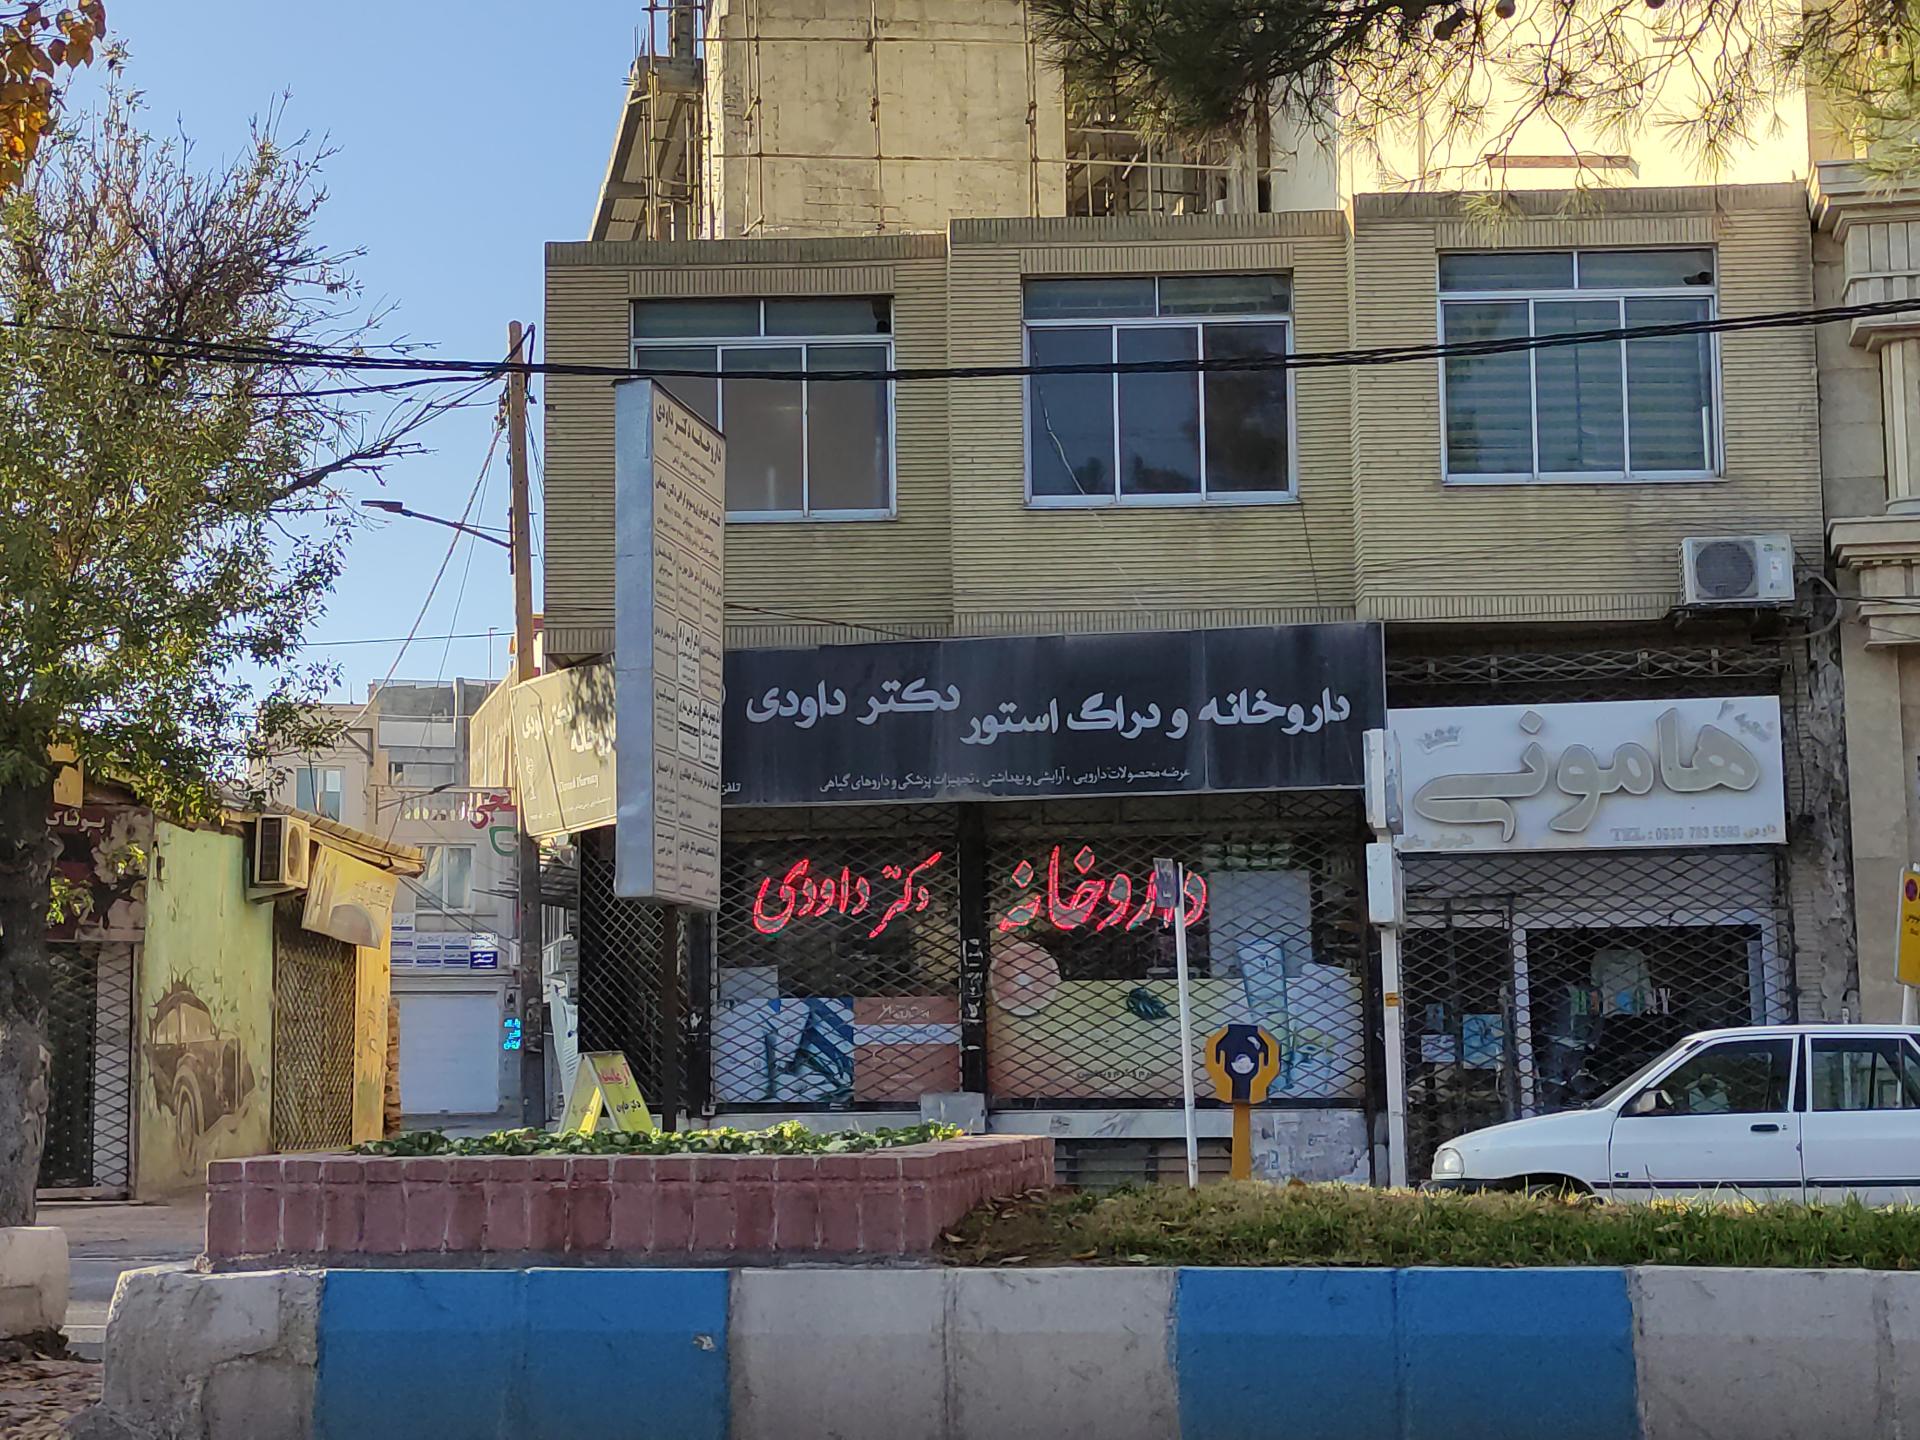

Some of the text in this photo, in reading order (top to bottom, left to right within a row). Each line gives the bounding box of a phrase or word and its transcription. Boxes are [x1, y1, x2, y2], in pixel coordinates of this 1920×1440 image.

[746, 679, 847, 729] داودی
[856, 677, 961, 725] دکتر
[1198, 687, 1351, 736] داروخانه
[960, 697, 1058, 745] استور
[1165, 708, 1189, 739] و
[819, 773, 851, 793] گیاهی
[850, 773, 890, 791] داروهای
[898, 772, 932, 790] پزشکی
[932, 772, 975, 790] تجهیزات
[982, 769, 1025, 788] بهداشتی
[1032, 766, 1066, 786] آرایشی
[1073, 765, 1107, 785] دارویی
[1108, 765, 1160, 784] محصولات
[1160, 766, 1191, 782] عرضه
[1414, 706, 1760, 842] هامونی
[45, 808, 106, 838] پوشاک
[753, 857, 871, 934] داودی
[868, 851, 943, 938] دکتر
[999, 845, 1207, 933] دروخانه
